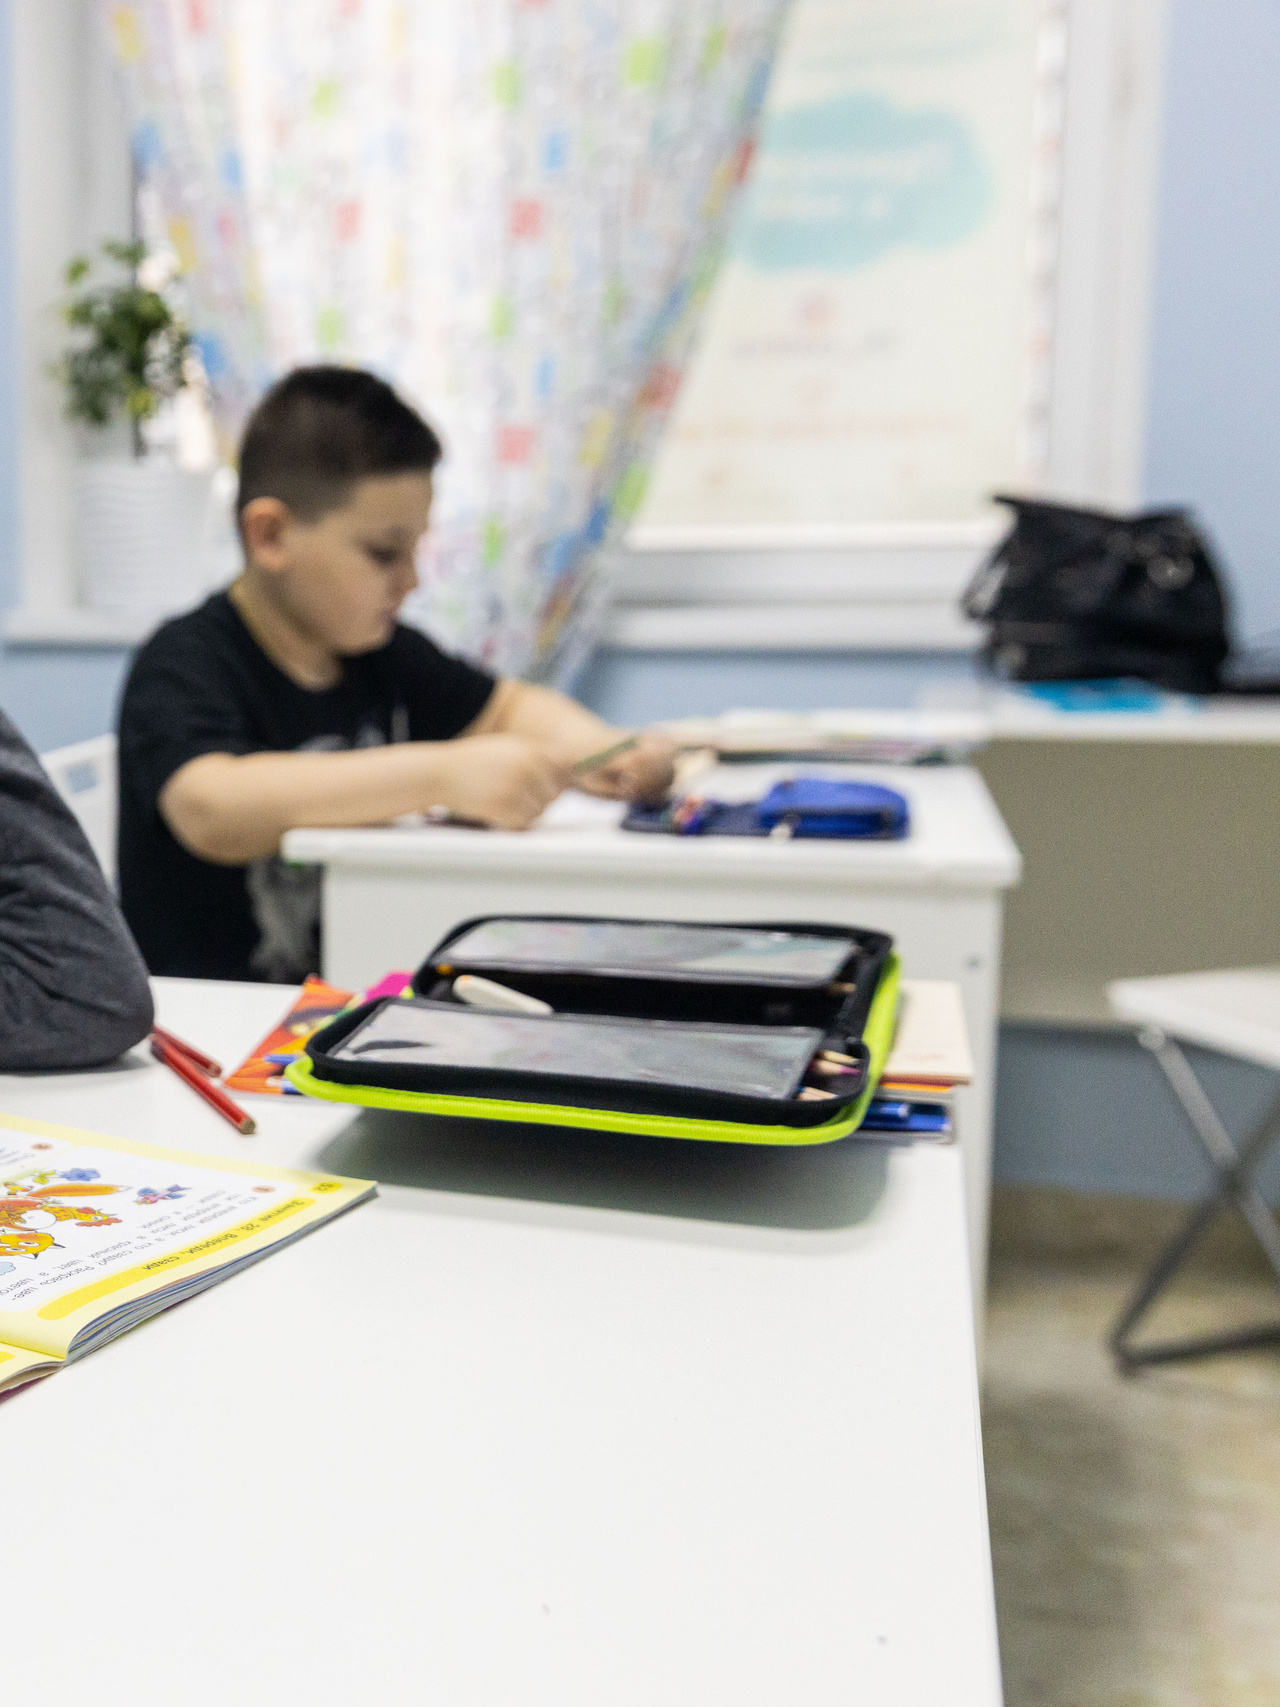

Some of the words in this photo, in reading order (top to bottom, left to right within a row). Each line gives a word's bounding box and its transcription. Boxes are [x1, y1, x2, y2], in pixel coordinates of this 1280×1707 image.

[178, 1203, 220, 1220] впереди
[194, 1205, 236, 1223] впереди
[257, 1200, 304, 1221] Занятие
[236, 1222, 260, 1232] 28.
[86, 1241, 133, 1258] красный
[132, 1241, 154, 1250] кто
[180, 1233, 237, 1254] Впереди,
[52, 1259, 83, 1270] цвет,
[94, 1250, 133, 1265] сзади?
[141, 1256, 180, 1270] сзади
[39, 1266, 94, 1286] Раскрась
[6, 1286, 39, 1300] цве-
